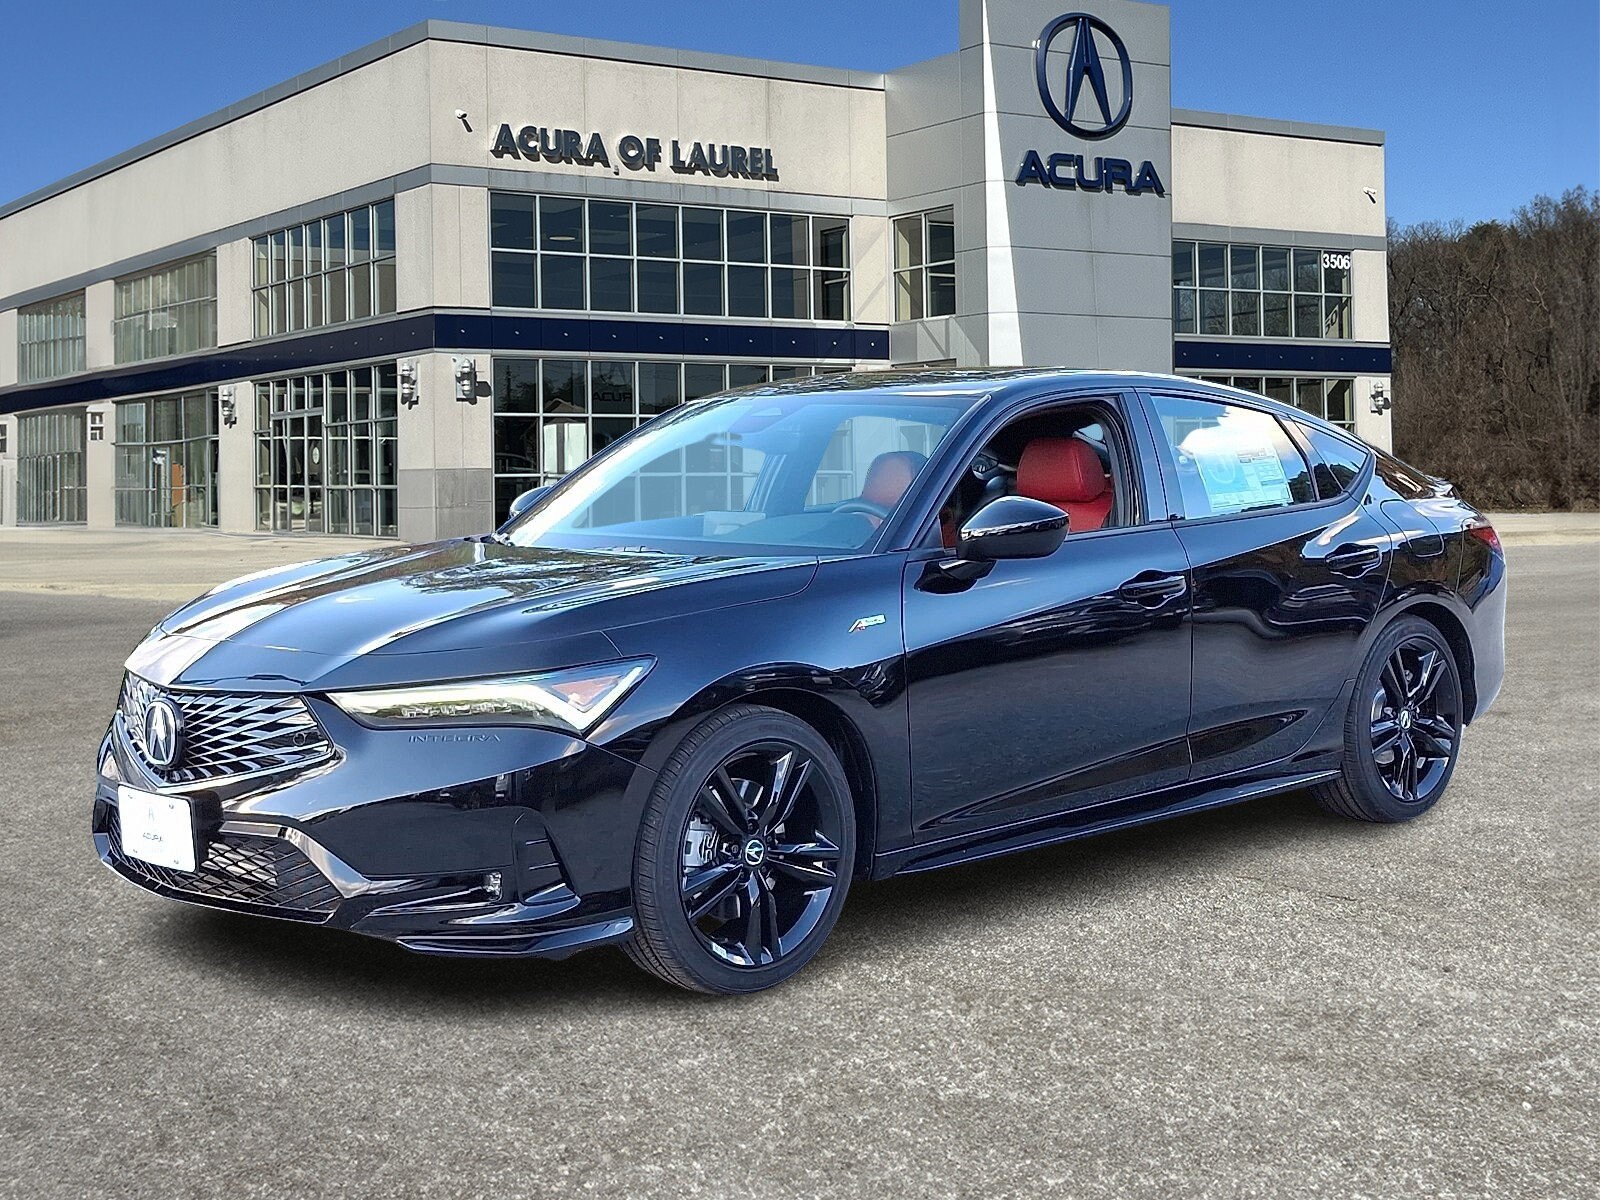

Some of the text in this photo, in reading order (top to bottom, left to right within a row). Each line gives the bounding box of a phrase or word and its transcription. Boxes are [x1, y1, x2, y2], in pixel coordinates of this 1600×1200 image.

[491, 123, 779, 181] ACURA OF LAUREL
[1016, 149, 1166, 198] ACURA
[1322, 252, 1351, 270] 3506
[592, 391, 633, 402] ACUR
[408, 733, 502, 743] INTEGRA
